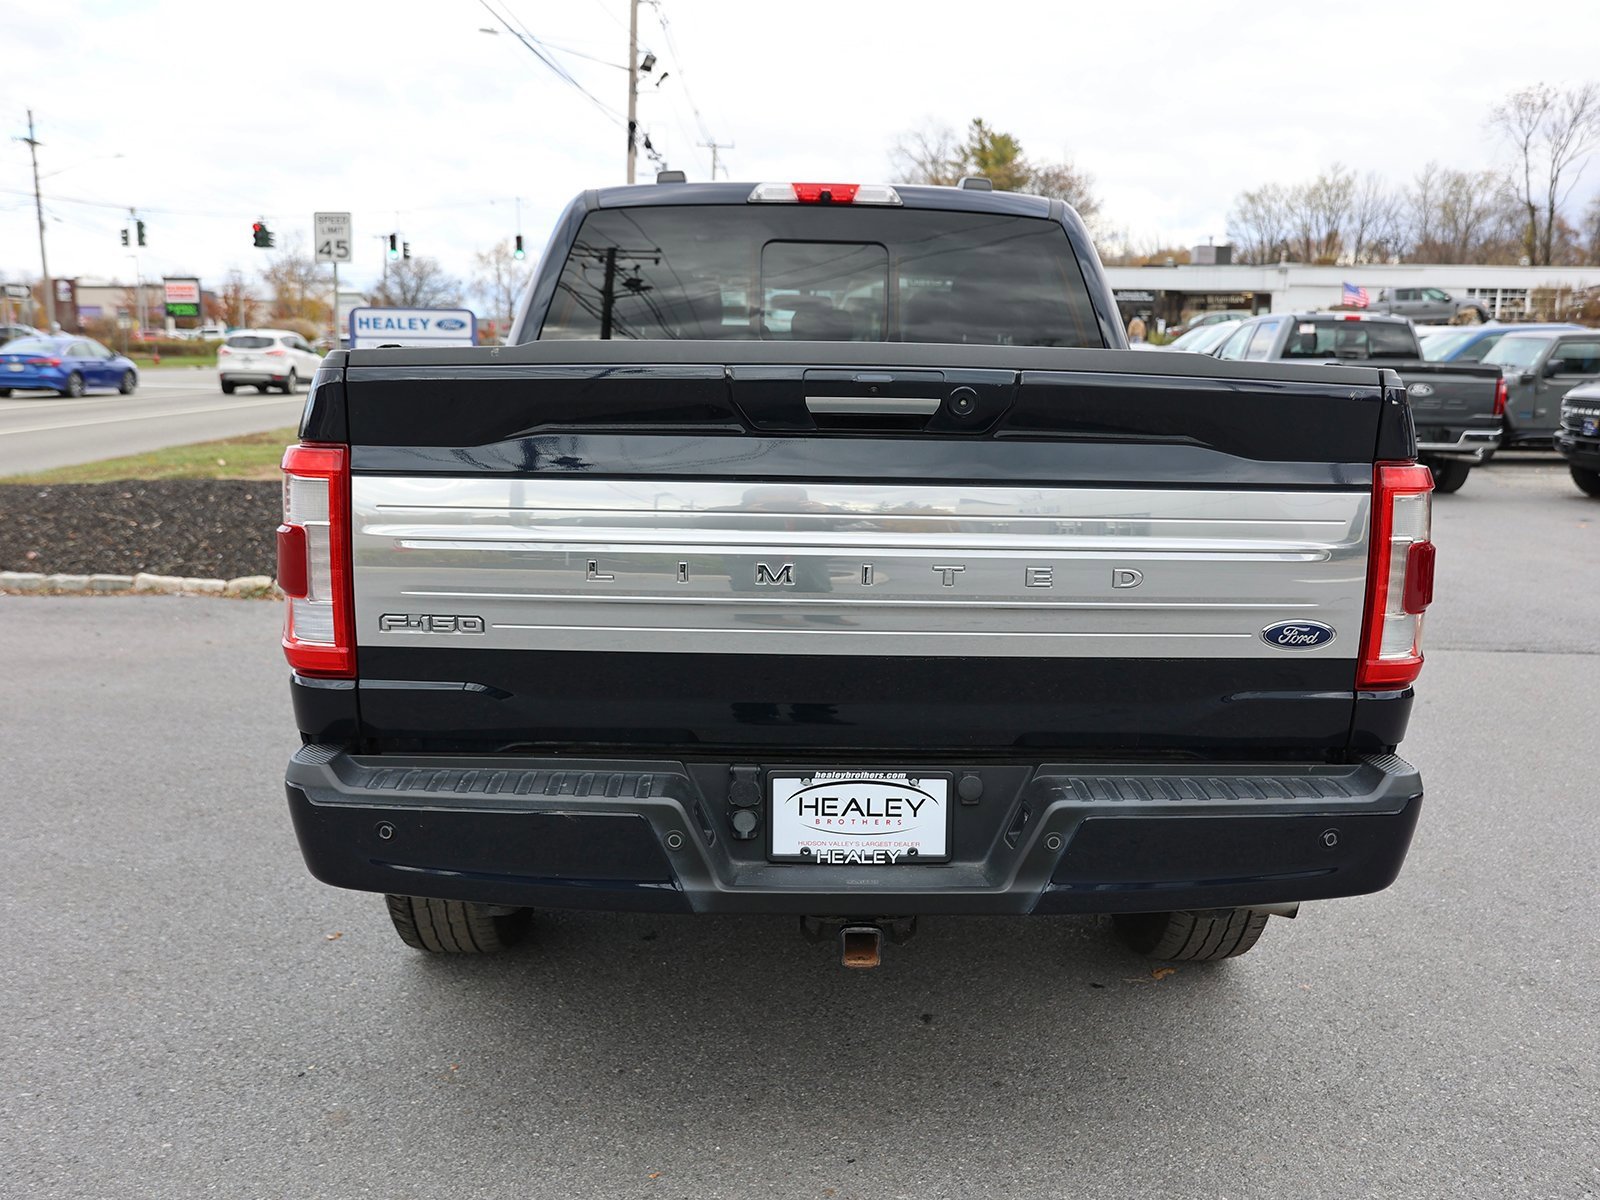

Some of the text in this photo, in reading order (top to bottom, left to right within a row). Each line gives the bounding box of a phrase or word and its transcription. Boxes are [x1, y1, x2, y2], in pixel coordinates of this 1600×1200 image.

[318, 216, 349, 225] SPEED
[322, 226, 344, 236] LIMIT
[318, 240, 349, 259] 45
[358, 317, 431, 330] HEALEY
[585, 558, 1145, 590] LIMITED
[379, 612, 485, 634] F-150
[1277, 625, 1320, 645] Ford
[814, 771, 907, 780] healeybrothers.com
[798, 796, 926, 818] HEALEY
[815, 818, 903, 826] BROTHERS
[816, 849, 902, 865] HEALEY
